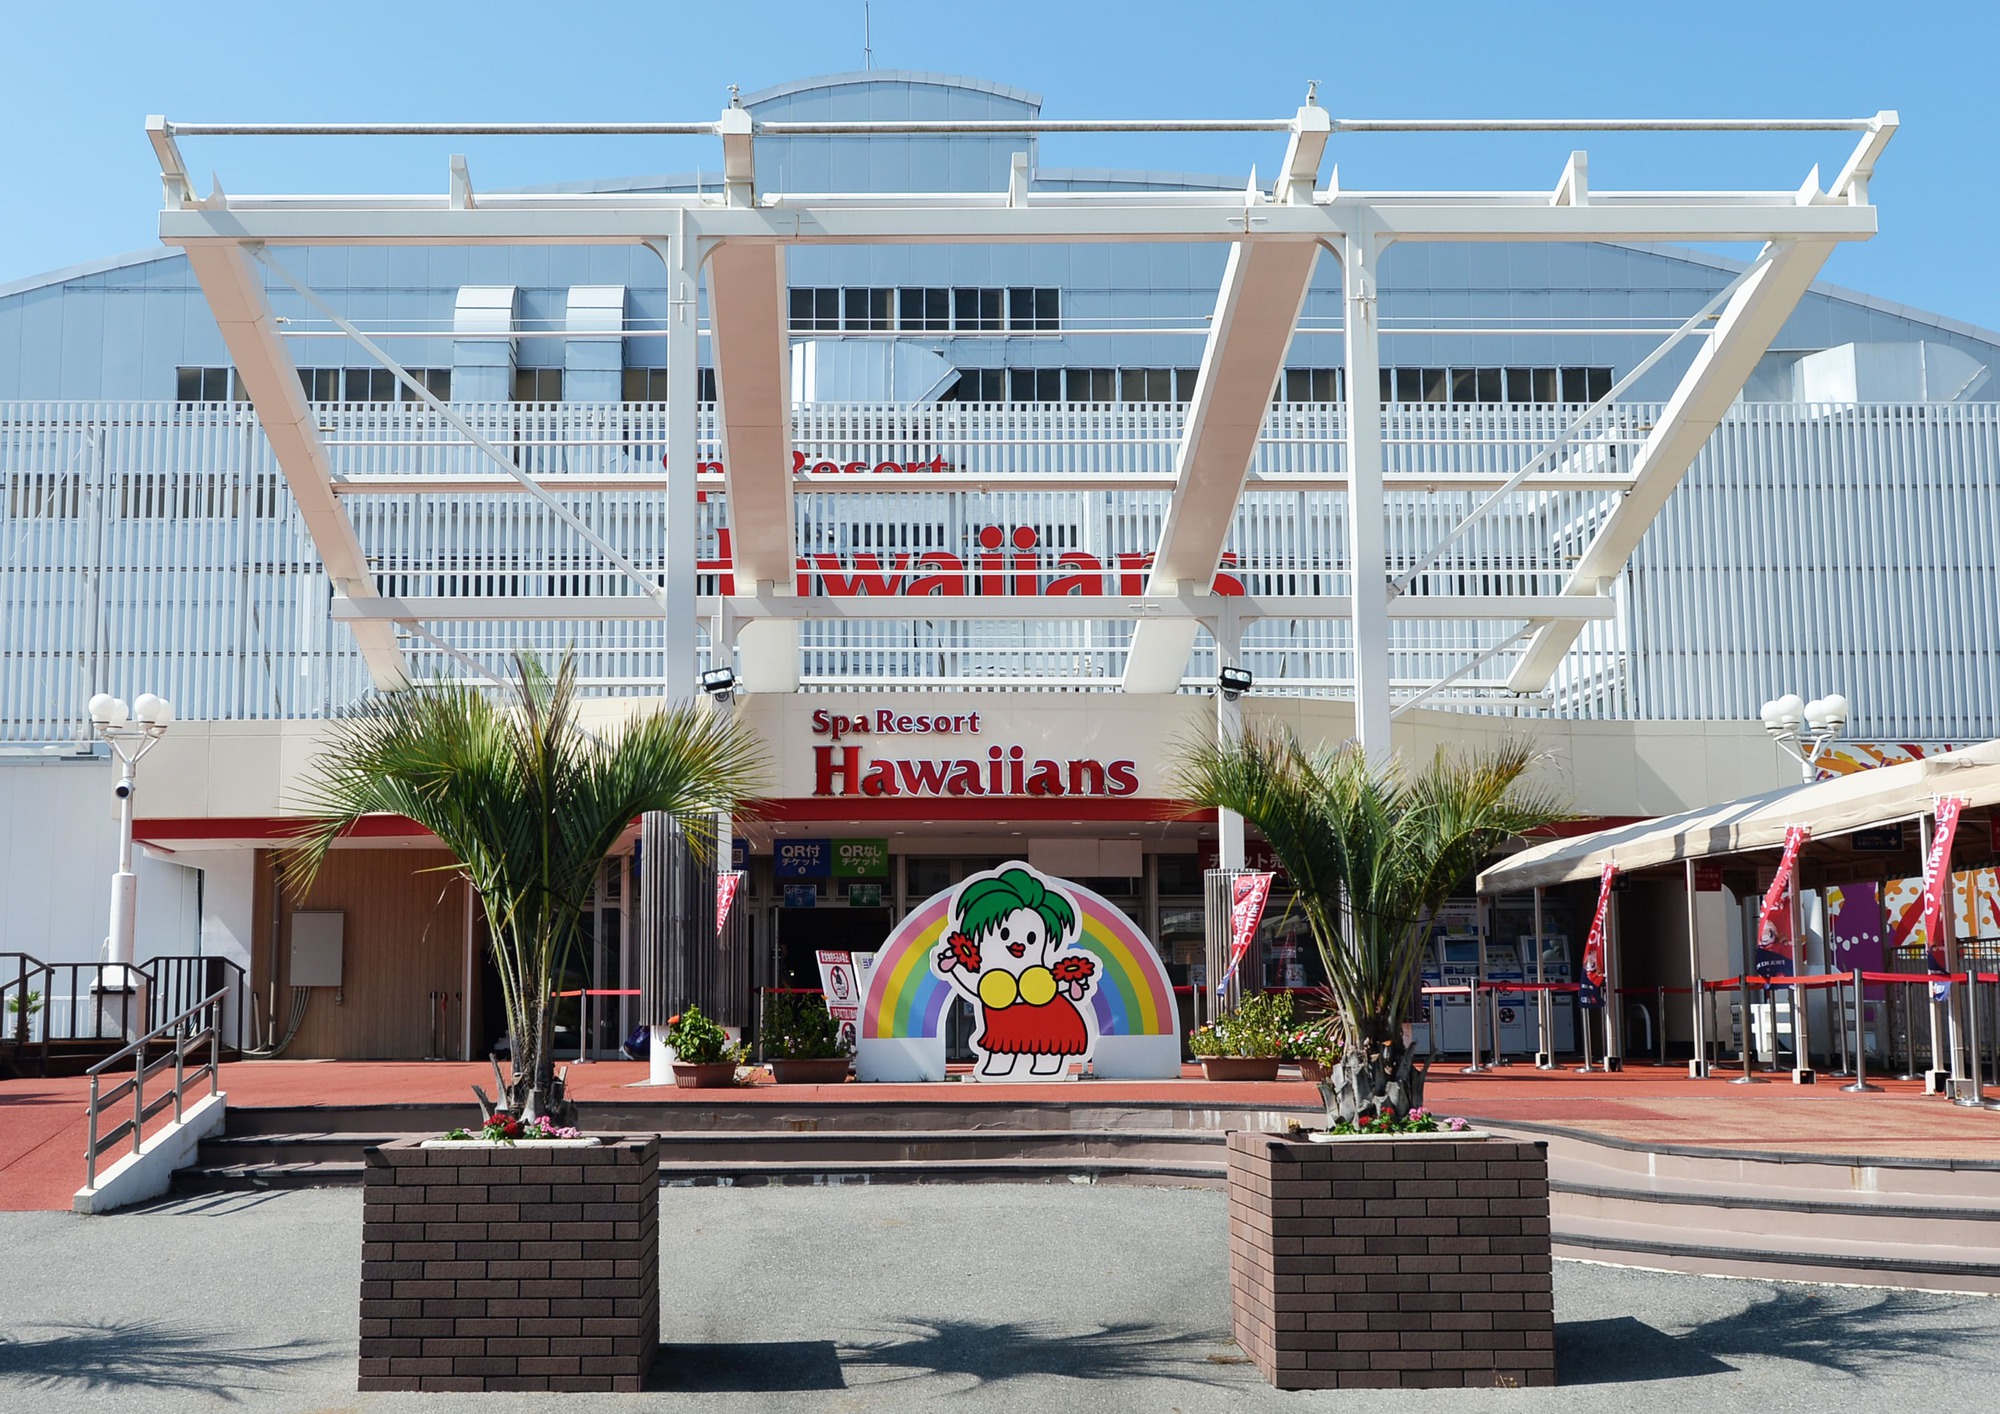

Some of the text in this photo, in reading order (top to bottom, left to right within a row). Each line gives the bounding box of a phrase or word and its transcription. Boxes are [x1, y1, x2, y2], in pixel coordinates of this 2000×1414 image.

[793, 450, 950, 474] esort
[812, 707, 983, 742] Spa Resort
[812, 744, 1141, 797] Hawaiians
[781, 845, 820, 858] QR付
[839, 845, 882, 858] QRなし
[781, 858, 820, 866] チケット
[841, 858, 880, 866] チケット
[1208, 852, 1286, 868] チット売
